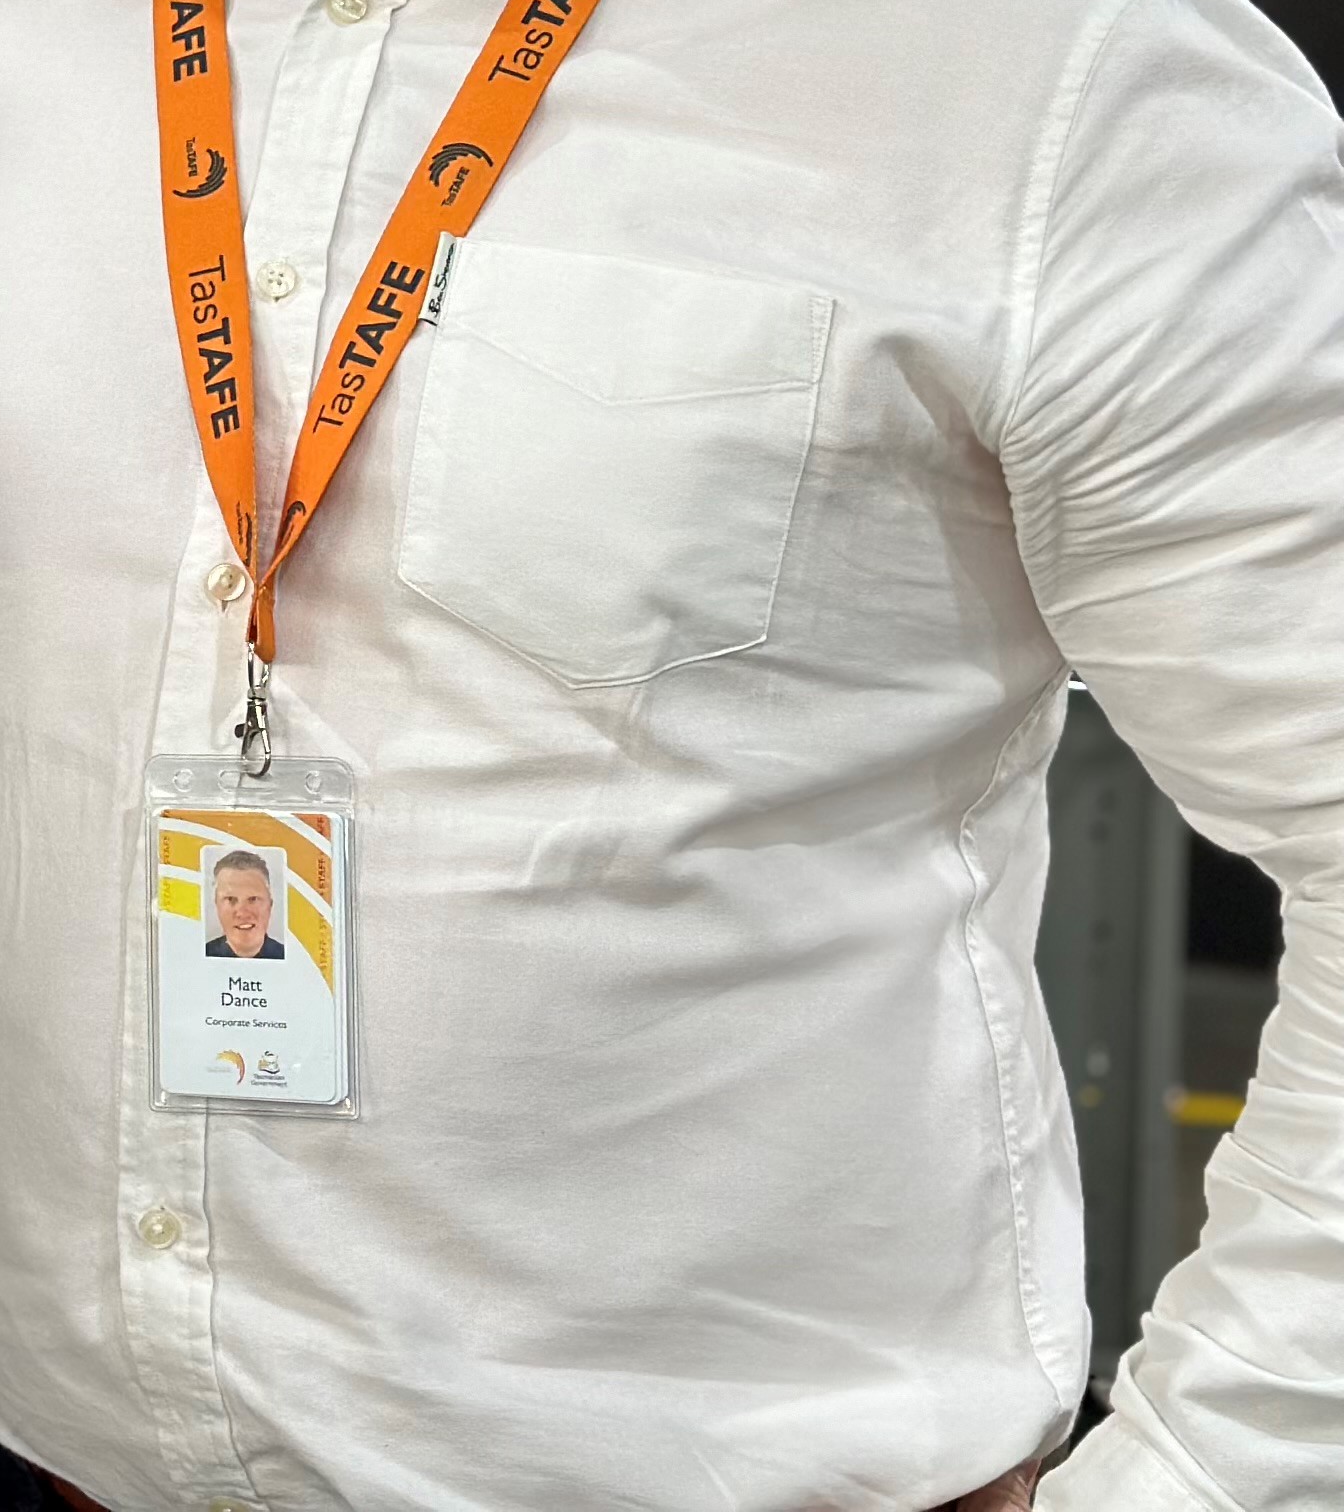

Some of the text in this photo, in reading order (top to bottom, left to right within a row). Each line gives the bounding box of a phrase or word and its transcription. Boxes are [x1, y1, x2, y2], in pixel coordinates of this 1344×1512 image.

[188, 254, 241, 440] TasTAFE
[312, 260, 426, 435] TasTAFE
[228, 976, 263, 991] Matt
[220, 992, 268, 1008] Dance
[205, 1016, 288, 1029] Corporate Services
